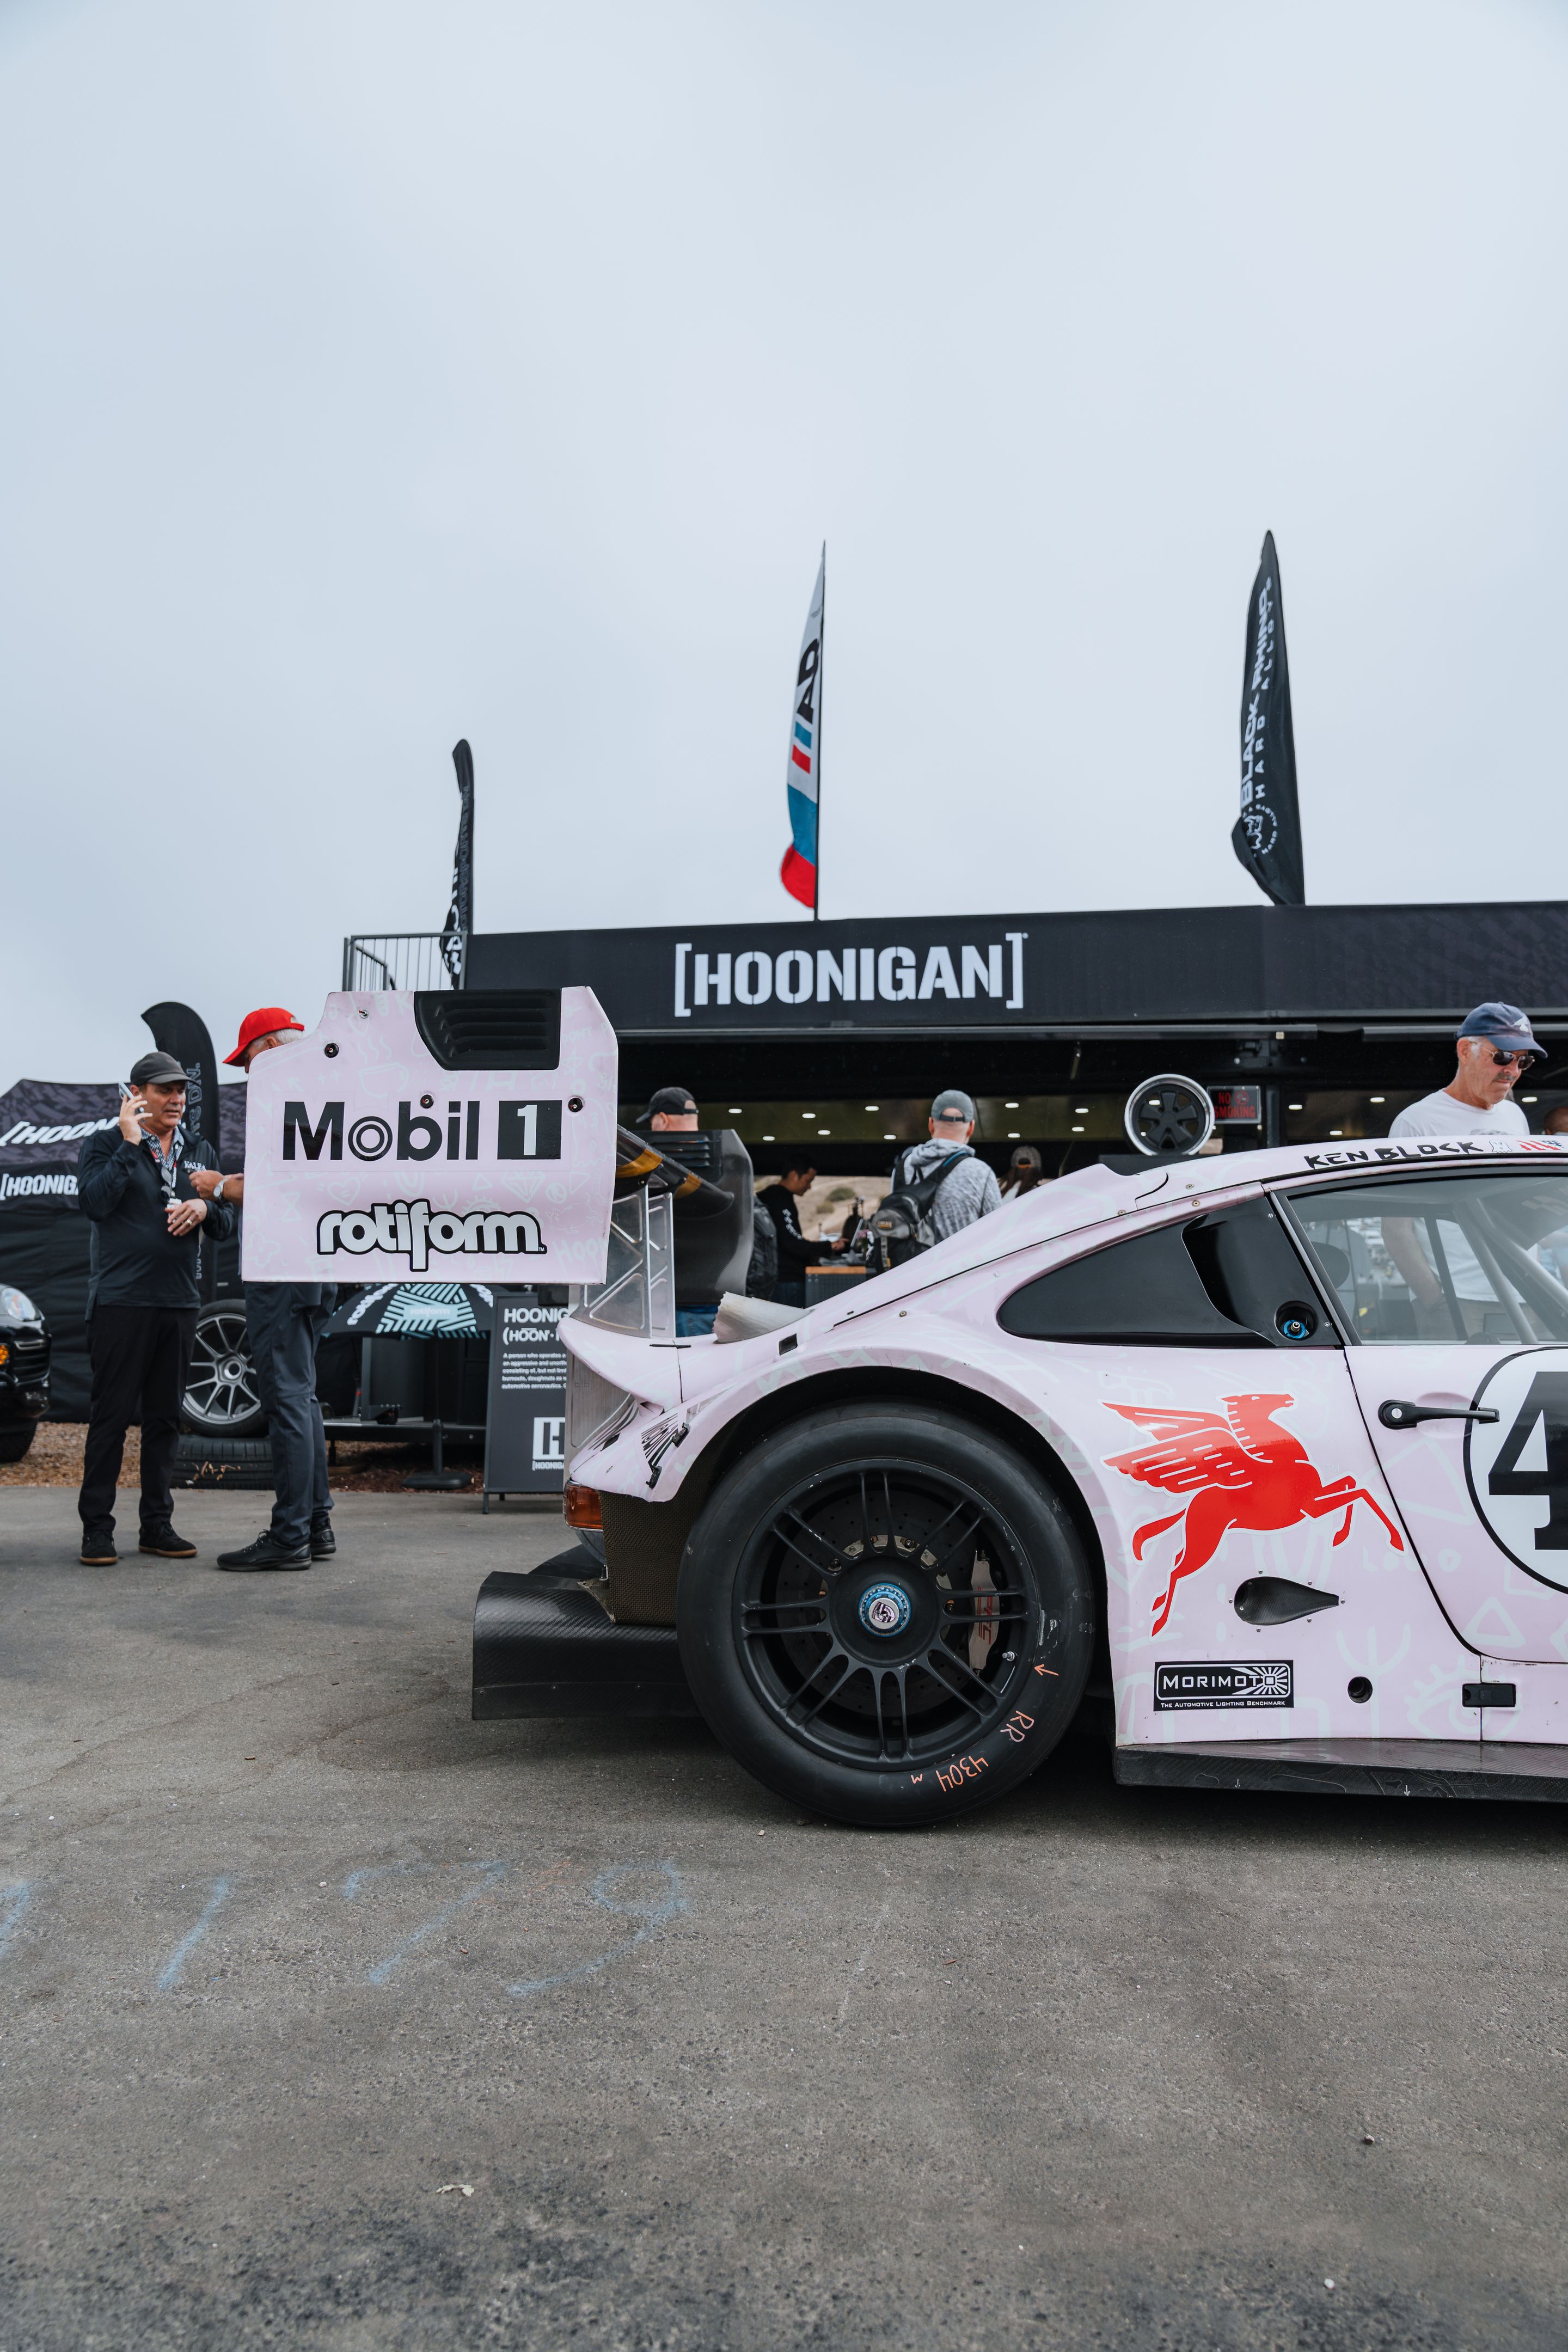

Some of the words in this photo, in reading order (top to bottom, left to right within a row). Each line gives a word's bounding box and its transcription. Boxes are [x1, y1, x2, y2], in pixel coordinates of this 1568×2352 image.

[1241, 693, 1259, 809] BLACK
[1255, 715, 1265, 799] HARD
[1214, 1105, 1255, 1119] SMOKING
[1218, 1091, 1232, 1105] NO
[283, 1101, 480, 1161] Mobil
[1303, 1150, 1369, 1170] KEN
[1374, 1142, 1484, 1161] BLOCK
[0, 1173, 78, 1200] [HOONIG
[319, 1200, 541, 1270] rotiform
